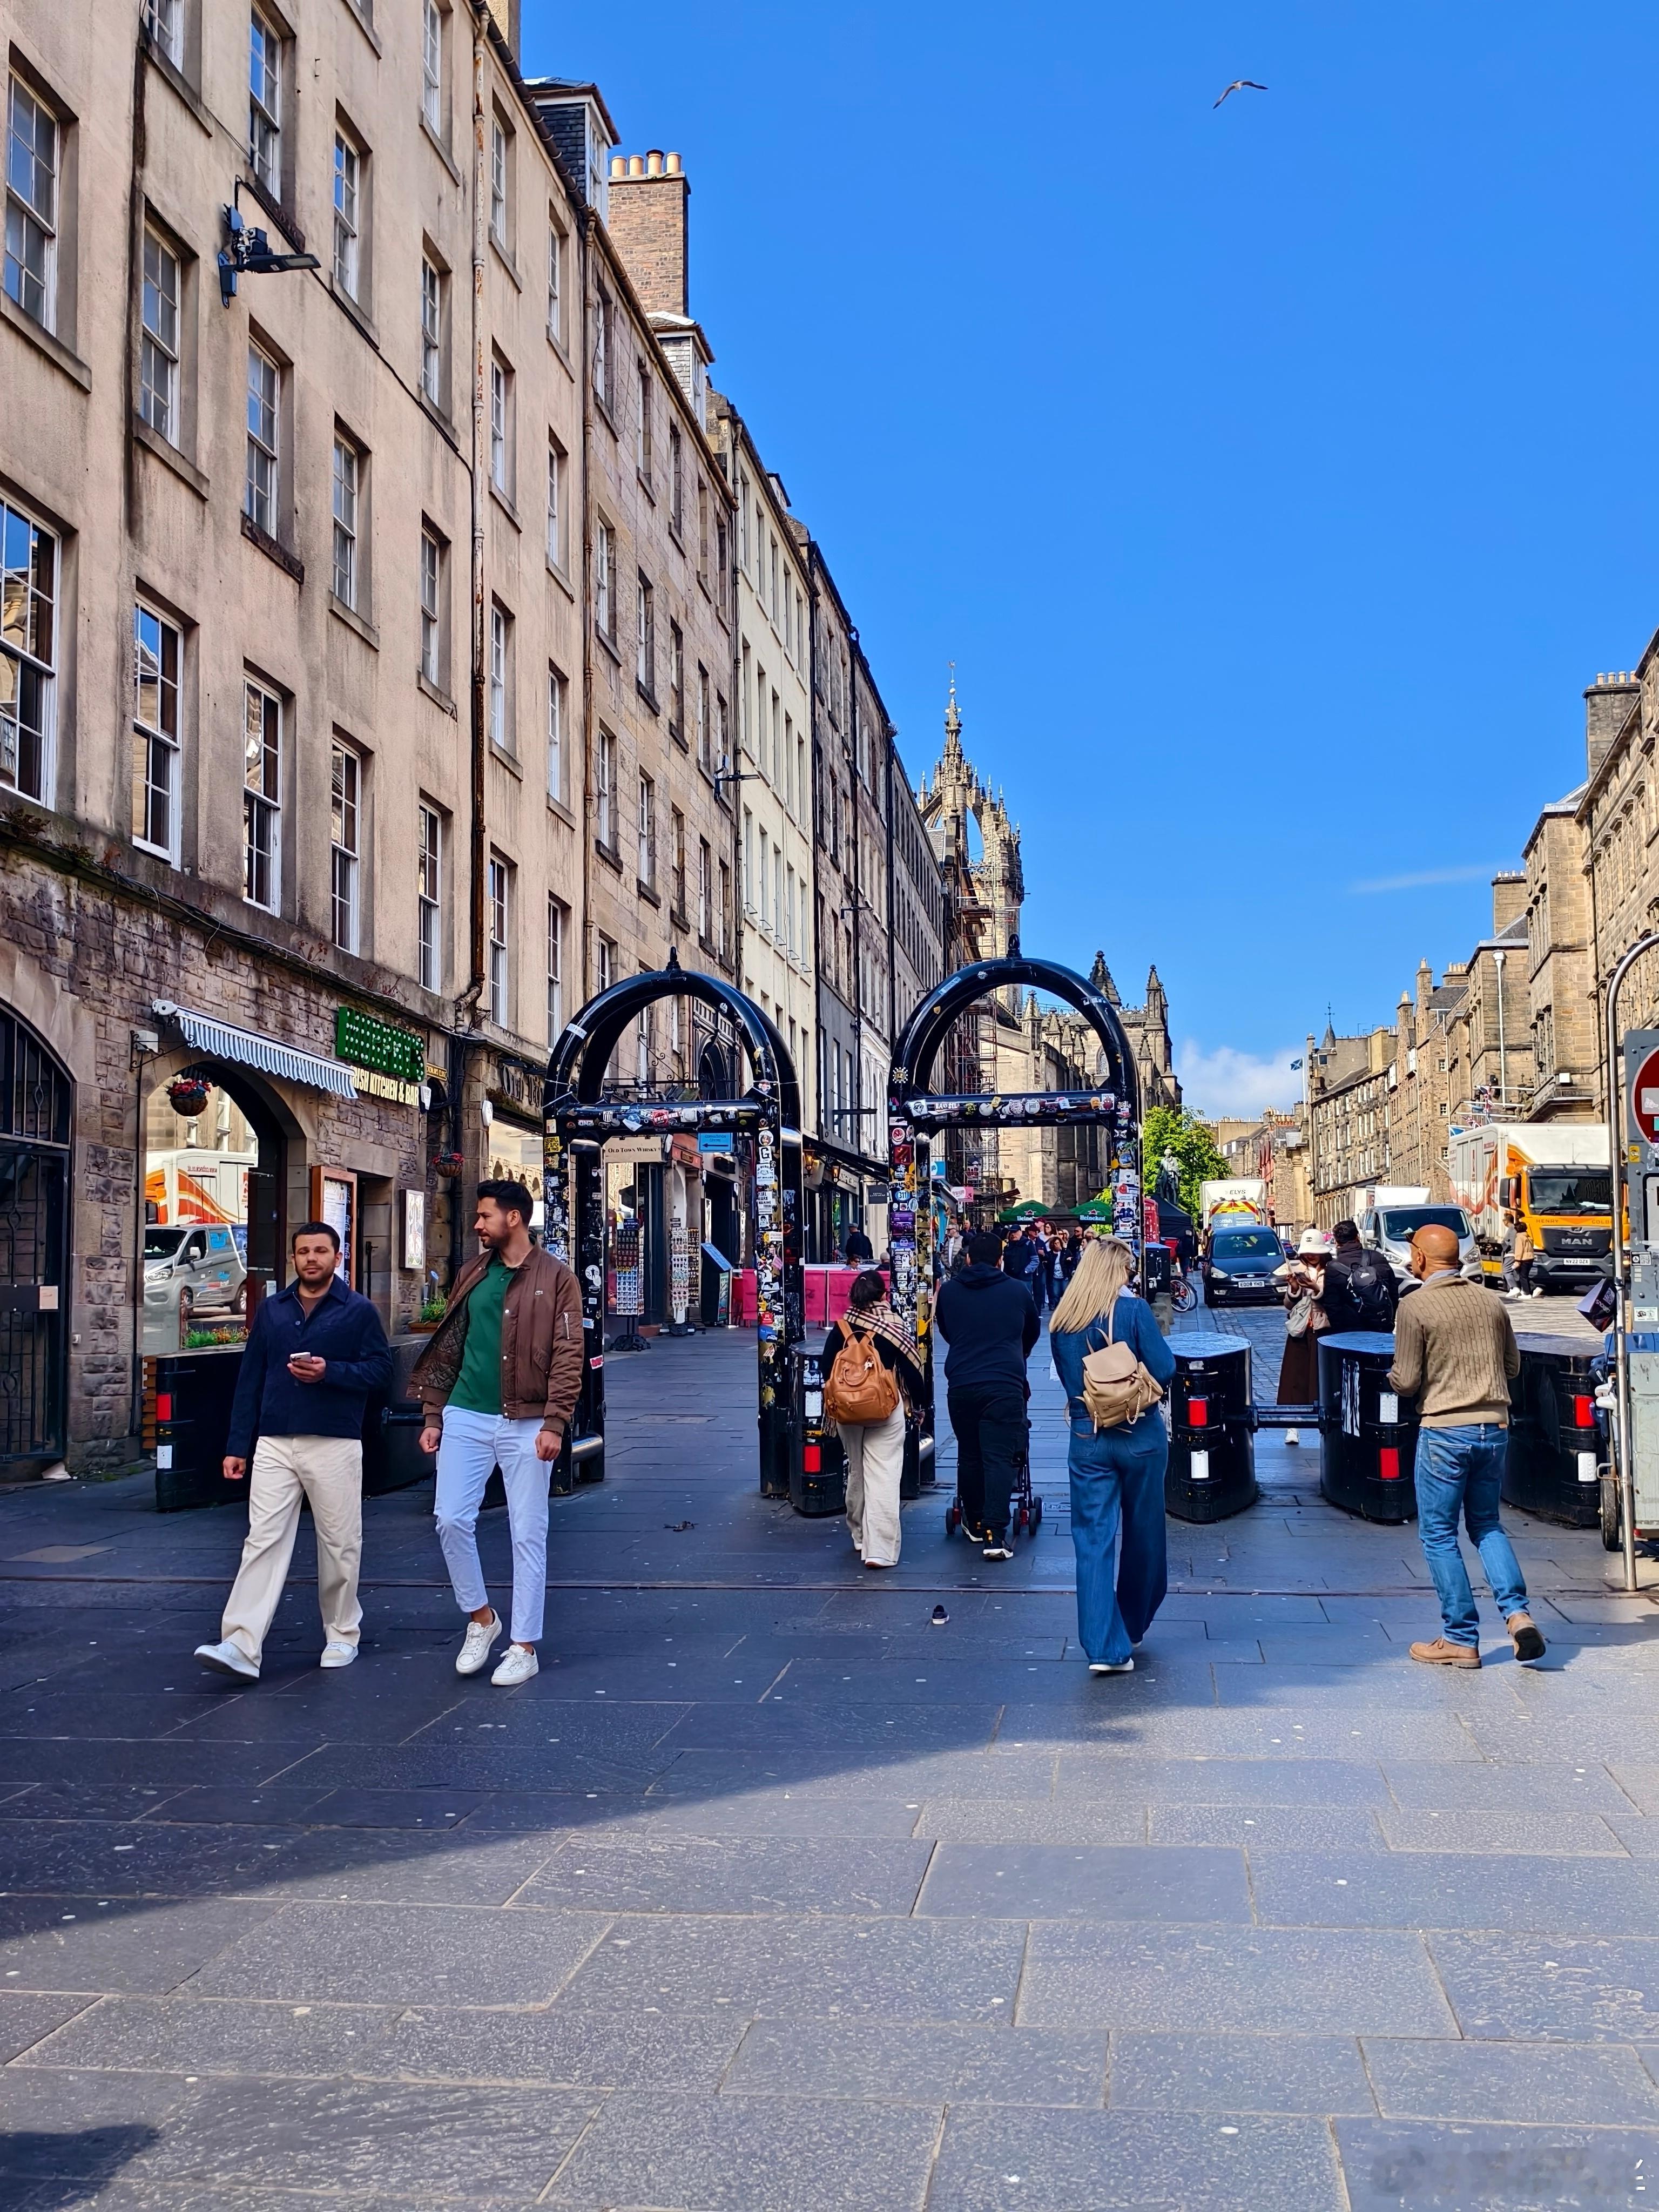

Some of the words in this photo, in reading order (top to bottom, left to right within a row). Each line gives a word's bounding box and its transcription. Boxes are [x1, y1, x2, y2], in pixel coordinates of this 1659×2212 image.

[369, 1073, 398, 1101] KITCHEN
[398, 1081, 404, 1103] &
[405, 1083, 419, 1107] BAR
